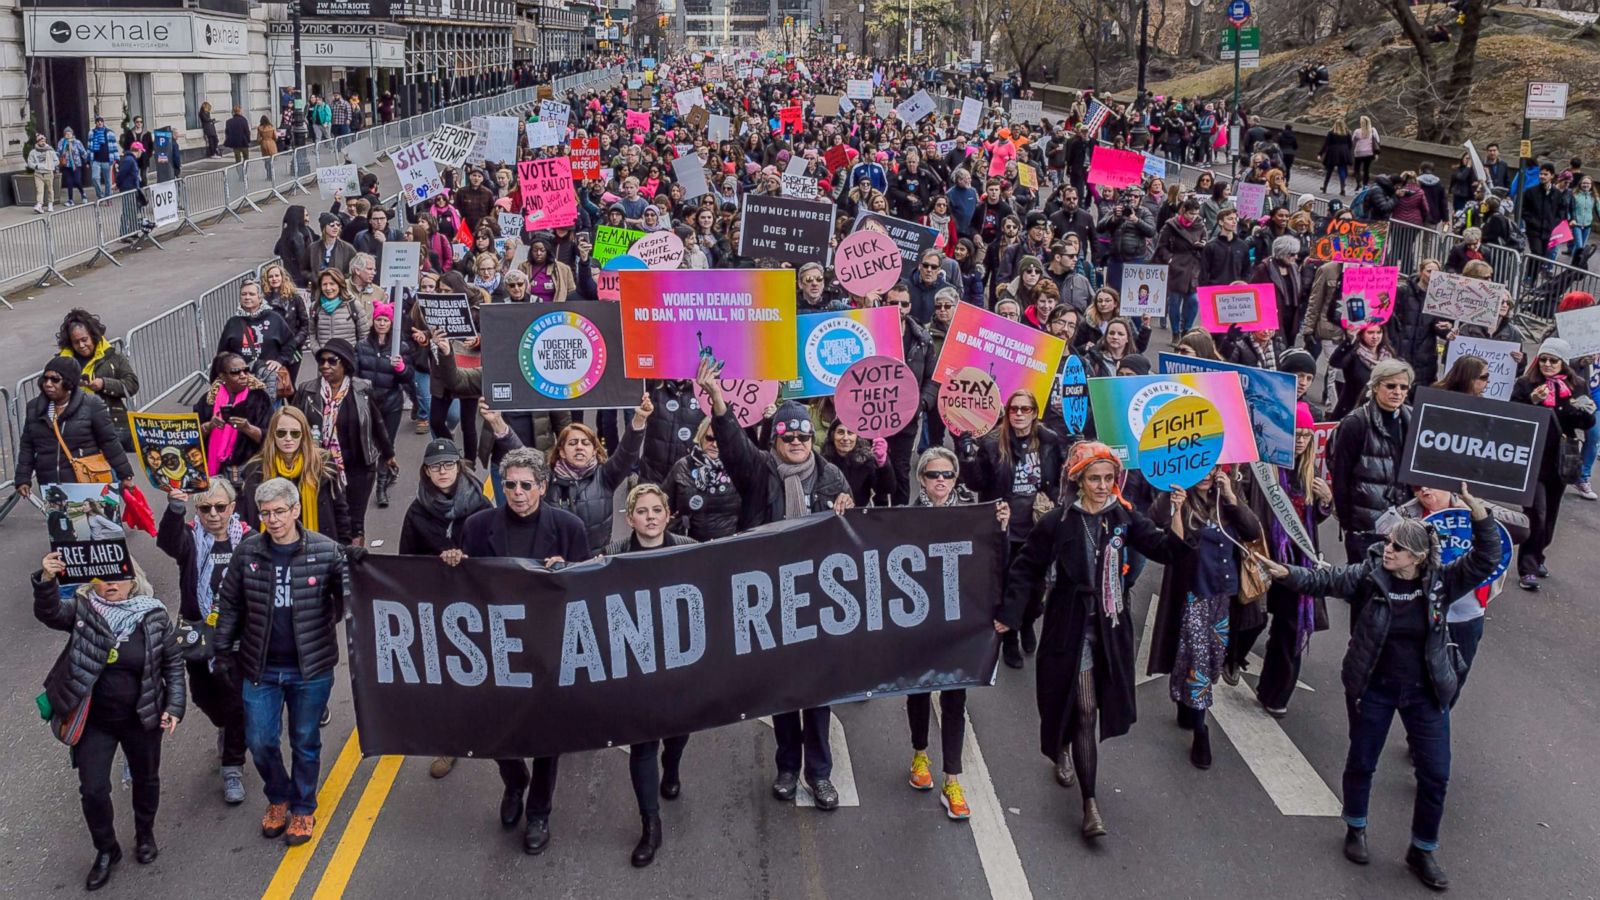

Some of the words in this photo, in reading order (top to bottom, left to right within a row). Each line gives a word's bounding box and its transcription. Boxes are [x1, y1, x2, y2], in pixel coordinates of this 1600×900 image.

[75, 20, 169, 41] exhale
[212, 24, 240, 44] exhale
[315, 43, 333, 54] 150
[434, 125, 476, 149] DEPORT
[396, 142, 429, 170] SHE
[430, 141, 466, 164] TRUMP
[520, 161, 558, 180] VOTE
[541, 177, 570, 192] BALLOT
[526, 195, 543, 211] AND
[504, 216, 517, 226] WE
[747, 204, 767, 214] HOW
[768, 206, 797, 218] MUCH
[799, 211, 831, 222] WORSE
[502, 226, 519, 236] SHUT
[763, 225, 787, 235] DOES
[793, 228, 804, 237] IT
[638, 236, 669, 249] RESIST
[752, 238, 776, 249] HAVE
[784, 242, 795, 252] TO
[843, 239, 885, 261] FUCK
[640, 245, 671, 258] WHITE
[840, 252, 901, 283] SILENCE
[1124, 268, 1137, 279] BOY
[1146, 268, 1159, 279] BYE
[662, 293, 703, 306] WOMEN
[706, 293, 752, 306] DEMAND
[1436, 288, 1453, 299] Elect
[440, 300, 467, 308] BELIEVE
[635, 308, 649, 321] NO
[652, 308, 676, 323] BAN,
[679, 308, 692, 321] NO
[695, 308, 728, 323] WALL,
[730, 308, 745, 321] NO
[748, 308, 782, 321] RAIDS.
[575, 318, 599, 342] MARCH
[541, 339, 583, 349] TOGETHER
[956, 331, 967, 342] NO
[983, 342, 995, 353] NO
[1015, 355, 1026, 365] NO
[979, 327, 1005, 346] WOMEN
[1004, 337, 1035, 355] DEMAND
[538, 350, 550, 359] WE
[552, 349, 570, 359] RISE
[572, 349, 587, 359] FOR
[1456, 343, 1508, 359] Schumer
[544, 360, 576, 370] JUSTICE
[1488, 362, 1510, 376] EMs
[851, 364, 904, 386] VOTE
[851, 386, 898, 403] THEM
[947, 379, 993, 396] STAY
[862, 400, 896, 416] OUT
[941, 395, 995, 410] TOGETHER
[858, 413, 900, 432] 2018
[1153, 409, 1209, 438] FIGHT
[1167, 434, 1203, 454] FOR
[1418, 429, 1531, 466] COURAGE
[1148, 451, 1211, 478] JUSTICE
[56, 546, 87, 565] FREE
[90, 544, 124, 563] AHED
[67, 566, 83, 577] FREE
[83, 564, 122, 576] PALESTINE
[372, 599, 533, 688] RISE
[558, 584, 706, 686] AND
[731, 541, 973, 655] RESIST
